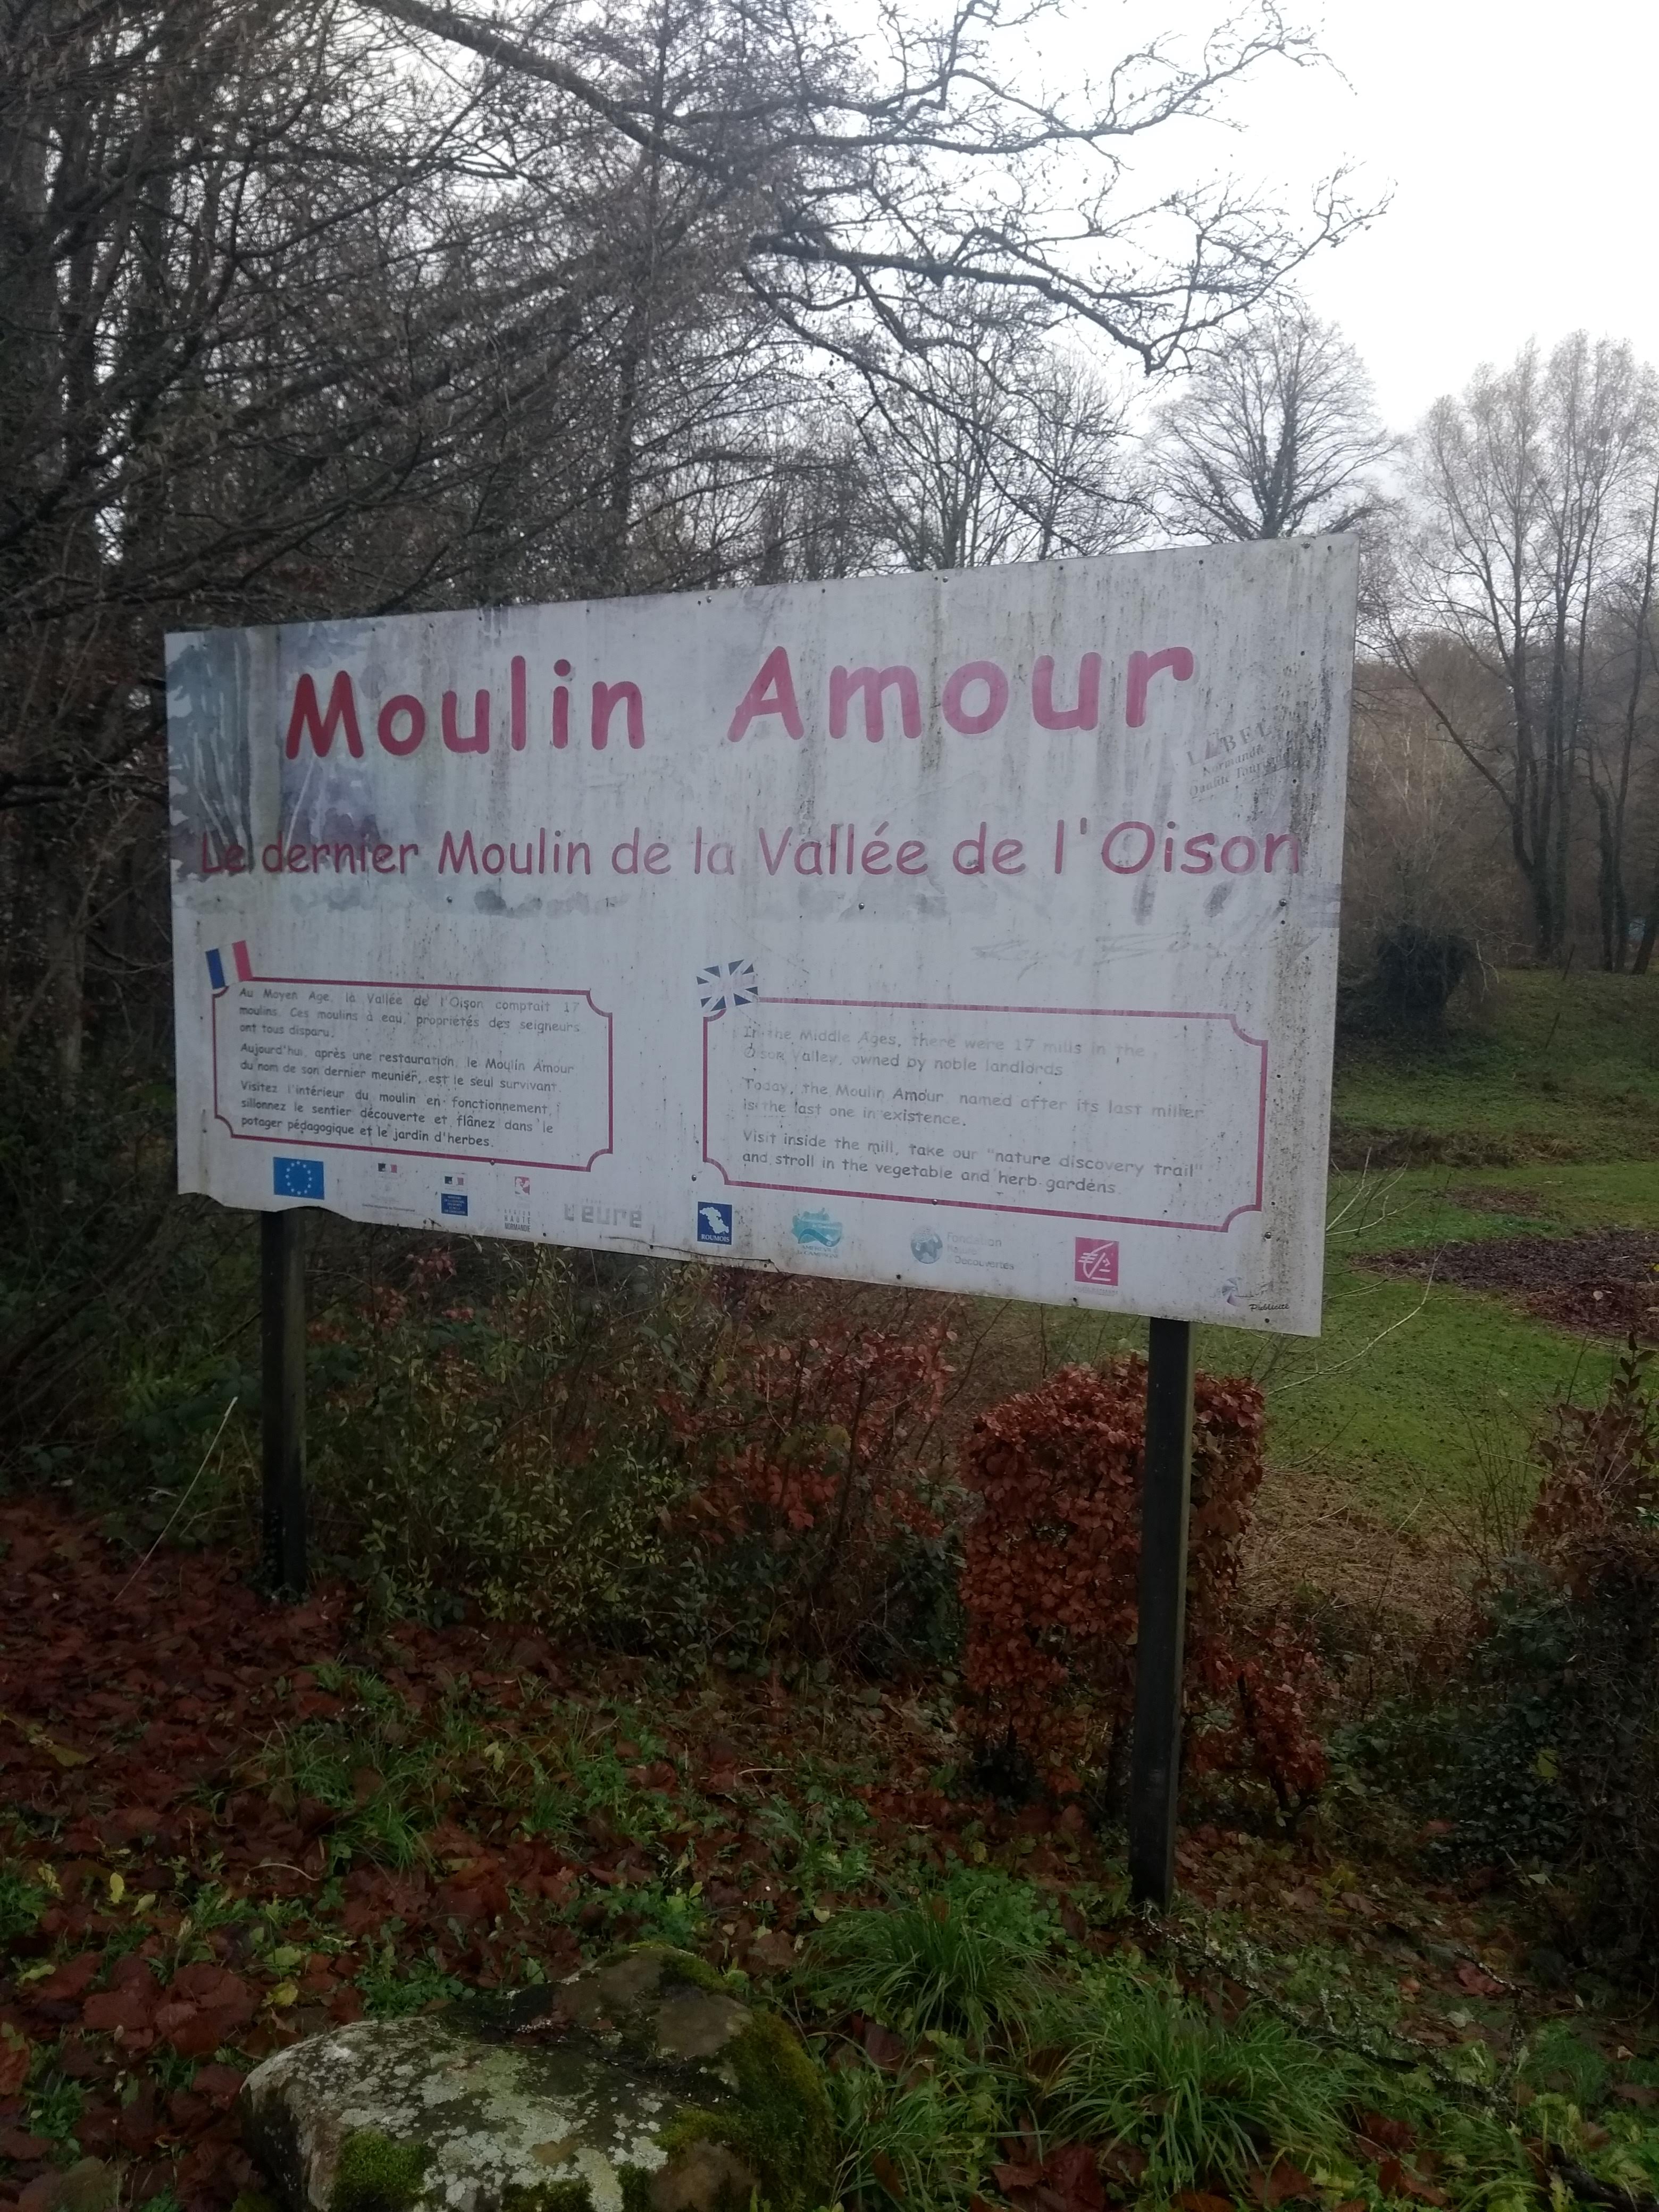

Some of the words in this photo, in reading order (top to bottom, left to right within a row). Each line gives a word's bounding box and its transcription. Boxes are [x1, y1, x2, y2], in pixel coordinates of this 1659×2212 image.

[286, 655, 645, 760] Moulin
[726, 646, 1194, 743] Amour
[202, 832, 247, 875] Le
[264, 830, 420, 875] dernier
[438, 828, 591, 876] Moulin
[611, 827, 671, 875] de
[694, 827, 734, 875] la
[758, 821, 929, 876] Vallée
[952, 821, 1026, 875] de
[1054, 819, 1301, 876] l'Oison
[239, 988, 253, 998] Au
[263, 988, 297, 1001] Moyen
[346, 993, 355, 1003] la
[367, 993, 403, 1005] Vallée
[414, 995, 427, 1007] de
[441, 996, 483, 1009] l'Oison
[496, 999, 550, 1013] comptait
[564, 1002, 580, 1013] 17
[239, 1024, 256, 1032] ont
[262, 1025, 283, 1034] tous
[289, 1025, 334, 1038] disparu.
[290, 1008, 308, 1018] Ces
[317, 1010, 357, 1021] moulins
[366, 1010, 373, 1022] à
[416, 1015, 479, 1027] propriétés
[489, 1017, 510, 1029] des
[520, 1019, 580, 1033] seigneurs
[767, 1027, 791, 1040] the
[800, 1029, 850, 1043] Middle
[858, 1031, 902, 1048] Ages,
[912, 1033, 956, 1048] there
[965, 1040, 1004, 1050] were
[1015, 1038, 1035, 1051] 17
[1043, 1042, 1082, 1054] mills
[1091, 1042, 1106, 1054] in
[1116, 1045, 1145, 1057] the
[315, 1048, 346, 1060] après
[353, 1052, 372, 1061] une
[468, 1057, 477, 1068] le
[485, 1058, 525, 1071] Moulin
[533, 1061, 574, 1074] Amour
[744, 1046, 785, 1060] Oson
[852, 1053, 900, 1067] owned
[907, 1057, 926, 1071] by
[934, 1057, 976, 1071] noble
[240, 1061, 253, 1070] du
[257, 1063, 278, 1073] nom
[283, 1063, 295, 1074] de
[302, 1066, 319, 1075] son
[324, 1066, 366, 1078] dernier
[372, 1070, 421, 1084] meunier,
[429, 1075, 448, 1084] est
[454, 1075, 464, 1085] le
[470, 1076, 493, 1088] seul
[241, 1080, 278, 1093] Visitez
[288, 1084, 345, 1098] l'intérieur
[355, 1090, 368, 1100] du
[380, 1092, 416, 1104] moulin
[426, 1095, 440, 1107] en
[452, 1096, 552, 1116] fonctionnement,
[744, 1077, 793, 1095] Today,
[802, 1082, 828, 1095] the
[836, 1084, 884, 1099] Moulin
[959, 1094, 1012, 1107] named
[1021, 1095, 1067, 1110] after
[1077, 1099, 1099, 1113] its
[1109, 1099, 1143, 1116] last
[241, 1099, 286, 1111] sillonnez
[295, 1102, 303, 1112] le
[312, 1105, 351, 1116] sentier
[361, 1108, 425, 1123] découverte
[434, 1115, 447, 1125] et
[457, 1116, 495, 1128] flânez
[505, 1120, 532, 1132] dans
[543, 1123, 553, 1133] le
[744, 1099, 755, 1110] is
[761, 1100, 786, 1113] the
[795, 1101, 822, 1116] last
[830, 1106, 854, 1117] one
[864, 1108, 875, 1119] in
[883, 1109, 966, 1126] existence.
[241, 1117, 282, 1129] potager
[288, 1118, 354, 1136] pédagogique
[359, 1127, 372, 1137] et
[378, 1126, 388, 1137] le
[393, 1129, 428, 1142] jardin
[434, 1132, 494, 1147] d'herbes.
[744, 1129, 776, 1144] Visit
[784, 1133, 826, 1147] inside
[834, 1136, 860, 1150] the
[868, 1139, 899, 1155] mill,
[909, 1144, 944, 1157] take
[953, 1147, 978, 1160] our
[988, 1148, 1051, 1166] "nature
[1059, 1155, 1145, 1177] discovery
[1154, 1162, 1203, 1177] trail"
[742, 1152, 767, 1163] and
[775, 1154, 814, 1167] stroll
[823, 1157, 834, 1169] in
[842, 1158, 868, 1171] the
[875, 1162, 953, 1179] vegetable
[961, 1170, 990, 1182] and
[998, 1170, 1037, 1186] herb
[504, 1215, 531, 1225] HAUTE
[504, 1222, 531, 1233] NORMANDIE
[701, 1234, 730, 1243] ROUMOIS
